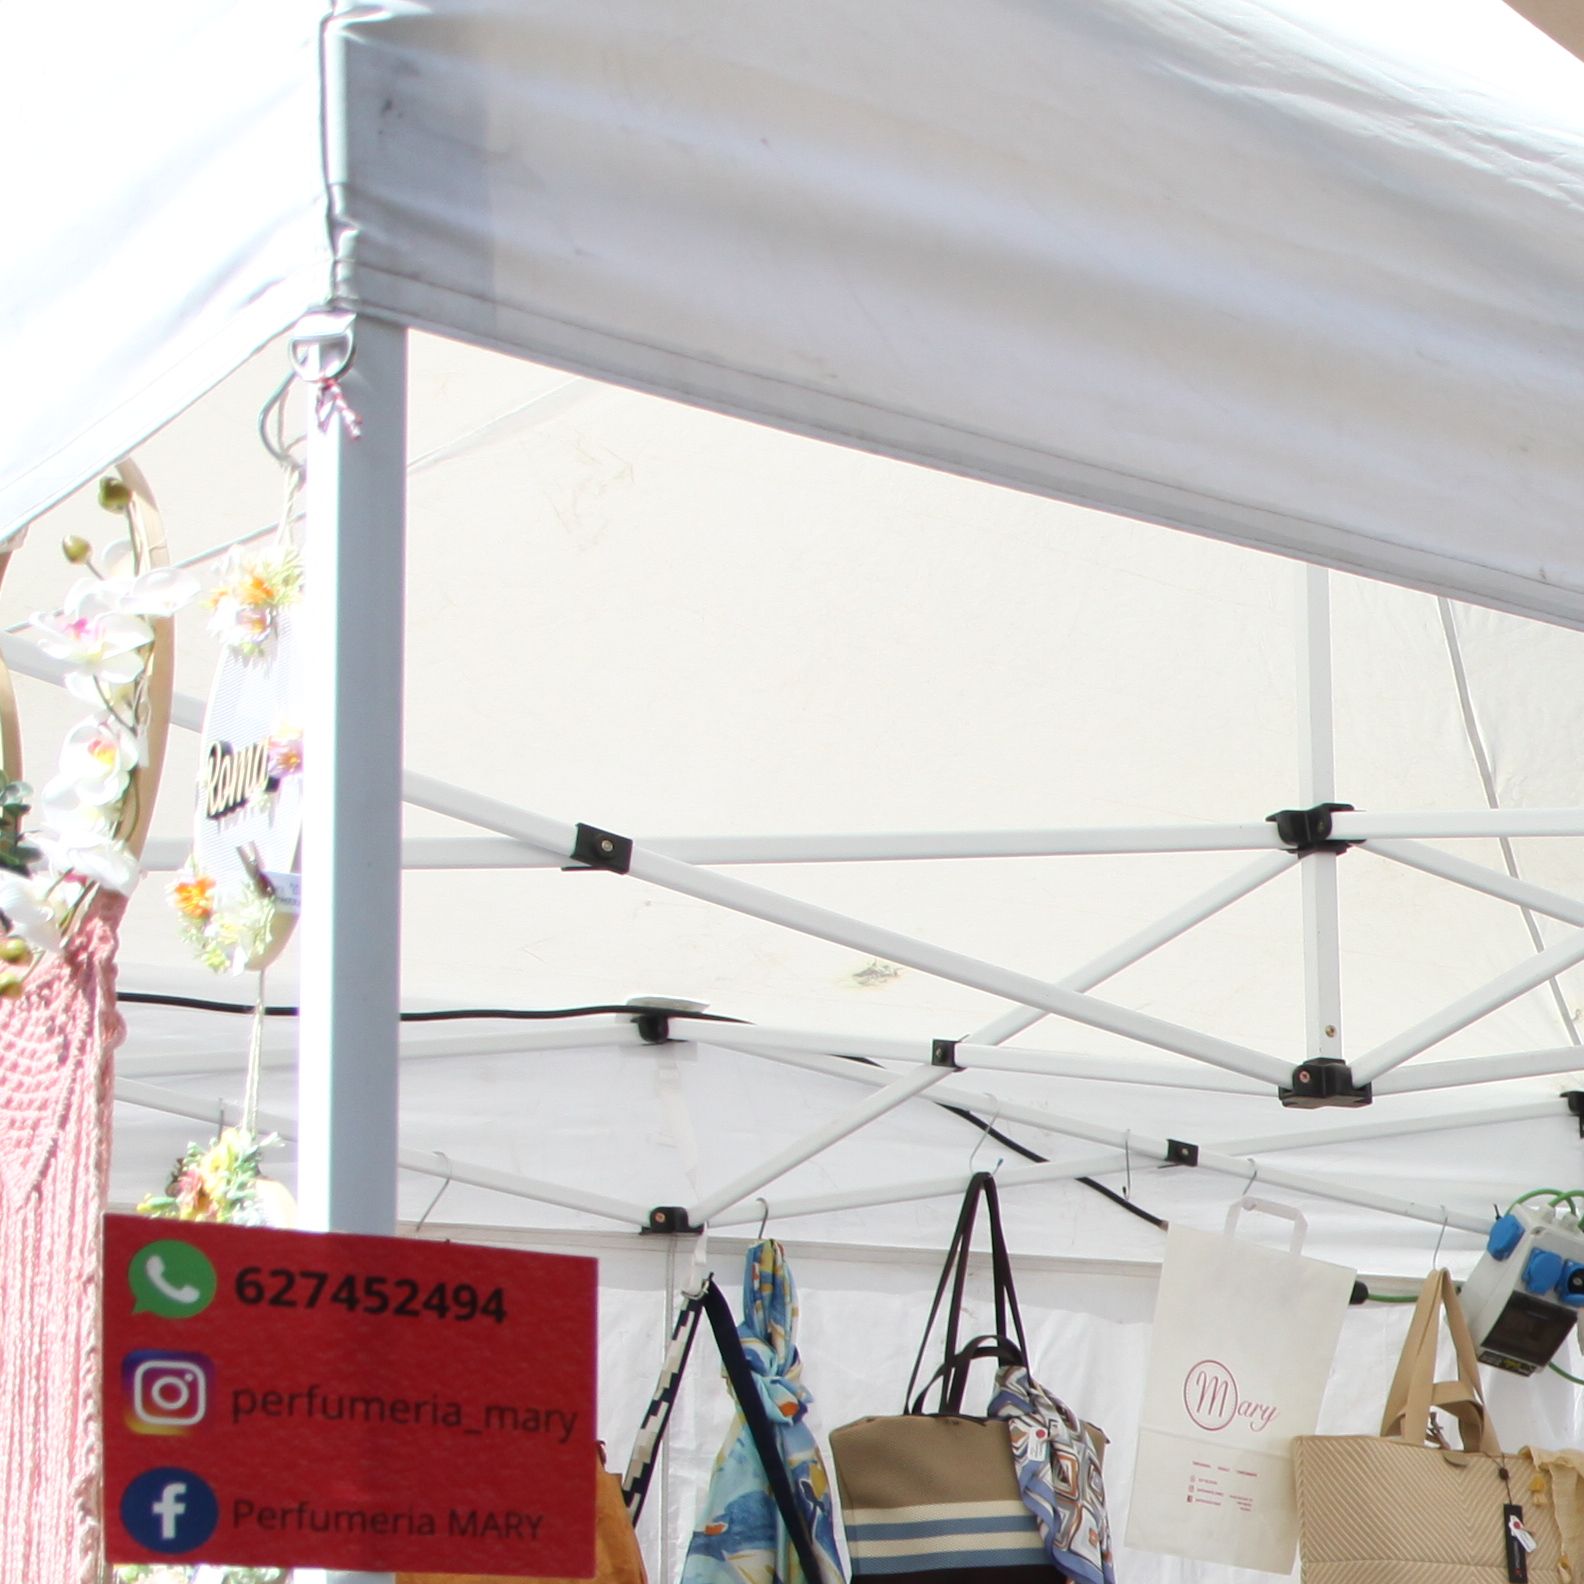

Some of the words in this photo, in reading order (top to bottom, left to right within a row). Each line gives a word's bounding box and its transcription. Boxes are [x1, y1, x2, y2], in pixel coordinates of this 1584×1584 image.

[233, 1266, 508, 1324] 627452494
[230, 1383, 579, 1446] perfumeria_mary
[1195, 1370, 1279, 1433] Mary
[232, 1499, 436, 1538] Perfumeria
[448, 1508, 545, 1541] MARY
